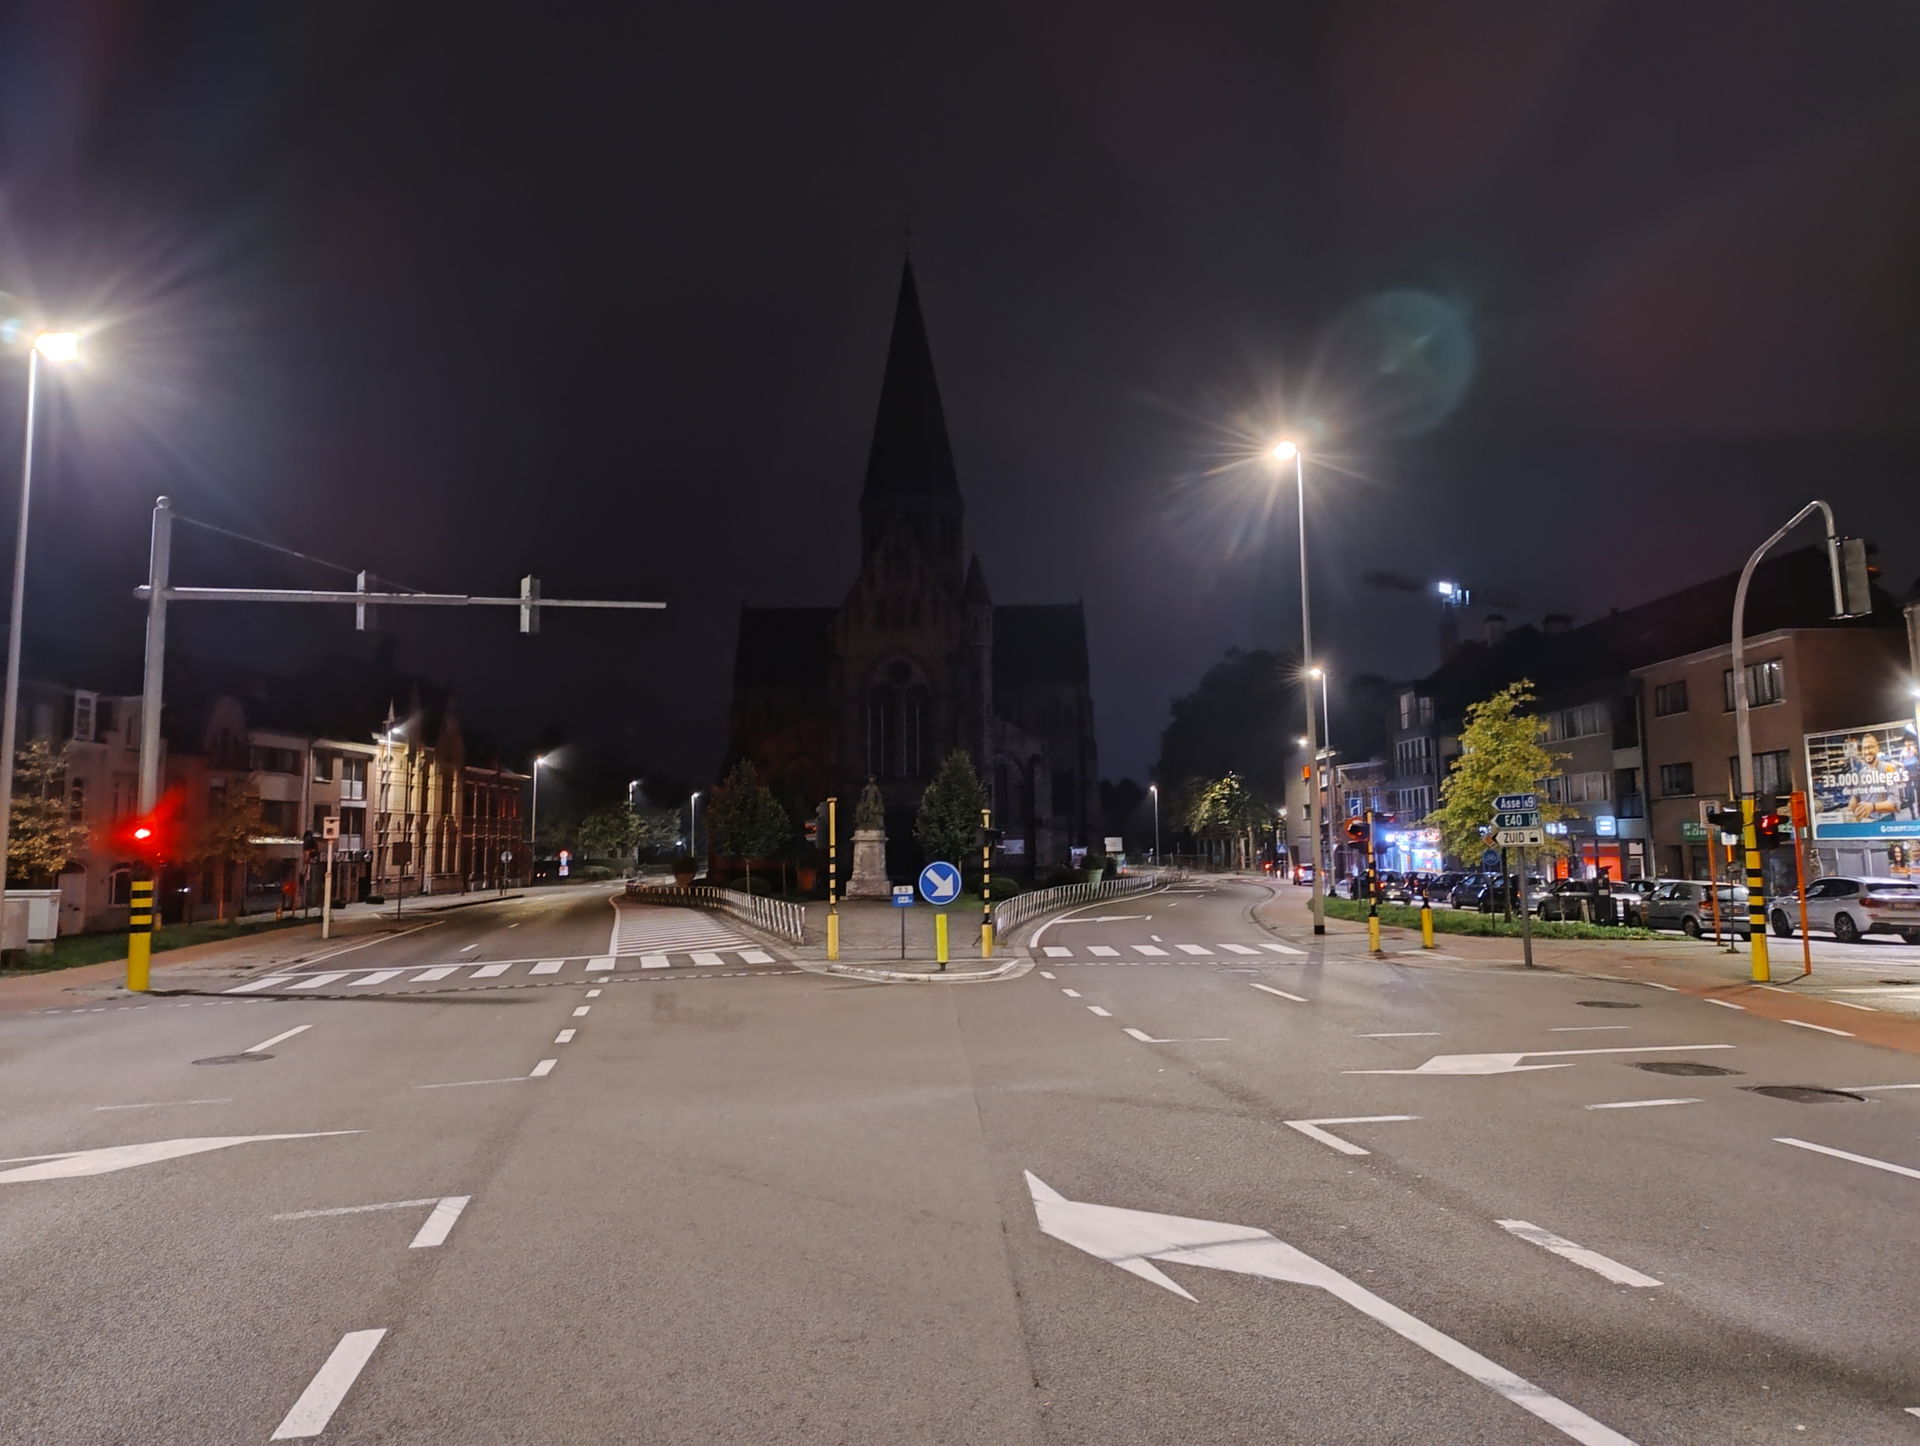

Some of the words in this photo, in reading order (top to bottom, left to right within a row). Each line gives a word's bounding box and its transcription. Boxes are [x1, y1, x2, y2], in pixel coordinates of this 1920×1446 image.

[1822, 773, 1858, 787] 33.000
[1861, 769, 1909, 785] collega's
[1501, 798, 1520, 808] Asse
[1505, 815, 1523, 826] E40
[1504, 832, 1525, 843] ZUID
